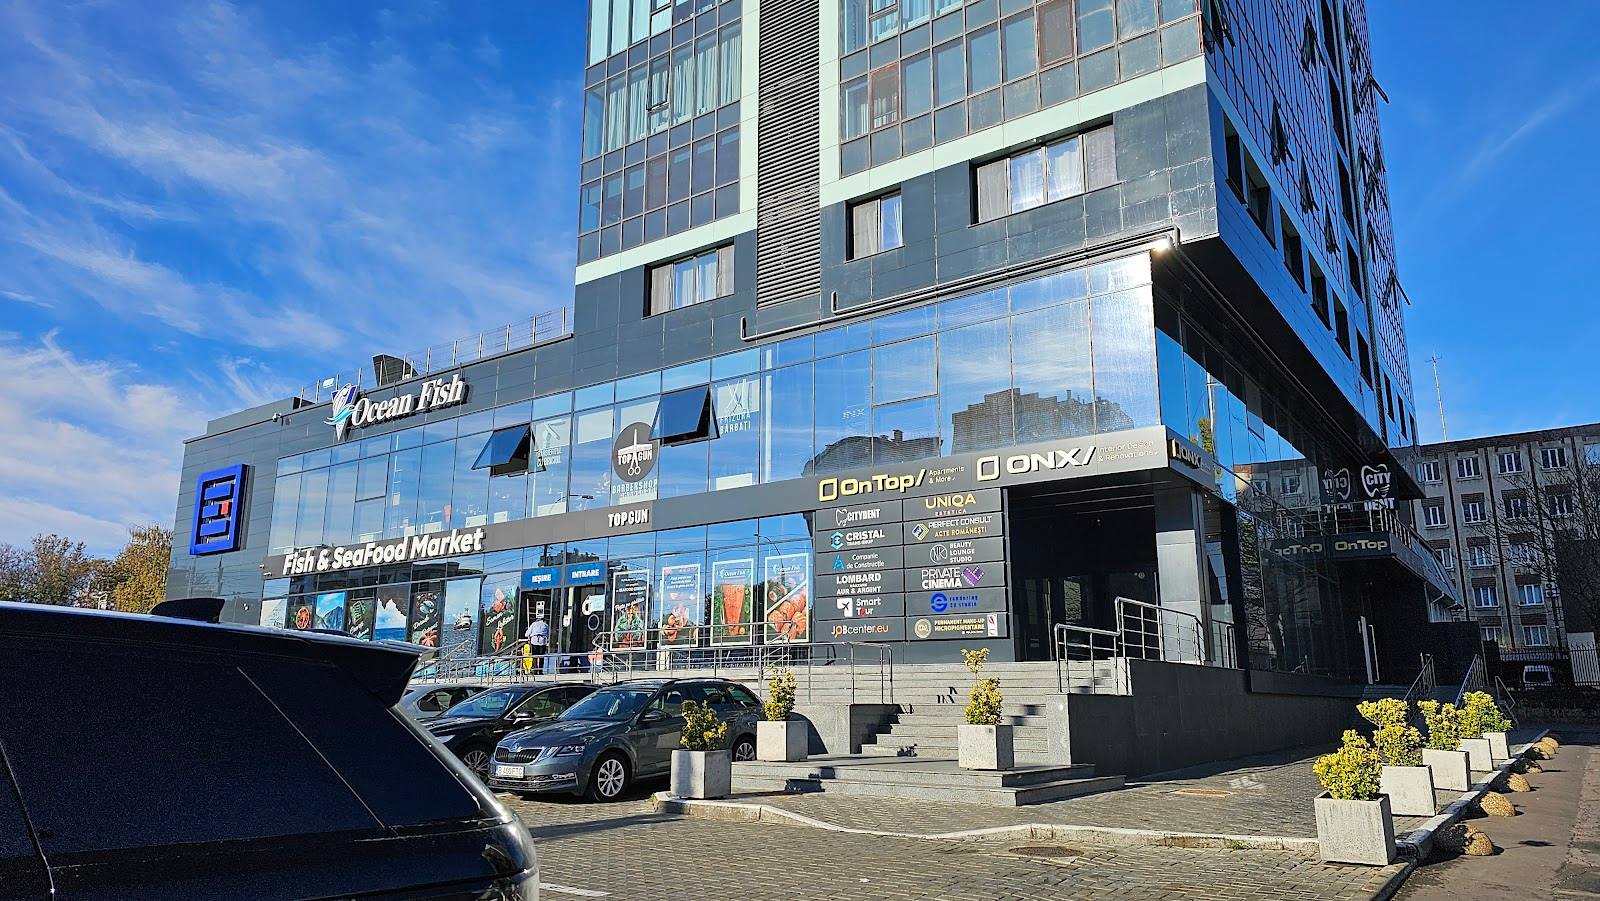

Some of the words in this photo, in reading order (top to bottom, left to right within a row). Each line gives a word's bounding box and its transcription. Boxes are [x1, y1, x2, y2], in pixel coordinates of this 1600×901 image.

[352, 393, 412, 426] Ocean
[416, 374, 464, 411] Fish
[1098, 443, 1125, 453] Interior
[618, 453, 632, 465] TOP
[638, 450, 652, 461] GUN
[929, 466, 965, 476] Apartments
[1366, 472, 1391, 485] CITY
[612, 479, 657, 494] BARBERSHOP
[925, 493, 976, 509] UNIQA
[847, 509, 880, 521] CITYDENT
[929, 519, 959, 528] PERFECT
[961, 516, 992, 526] CONSULT
[846, 529, 885, 541] CRISTAL
[949, 541, 972, 549] BEAUTY
[1334, 539, 1388, 551] OnTop
[283, 552, 315, 575] Fish
[317, 549, 329, 571] &
[332, 536, 409, 569] SeaFood
[410, 528, 485, 559] Market
[852, 553, 878, 561] Companie
[571, 569, 600, 579] INTRARE
[837, 573, 881, 584] LOMBARD
[921, 567, 960, 579] PRIVATE
[922, 578, 962, 589] CINEMA
[857, 586, 881, 594] ARGINT
[856, 597, 881, 606] Smart
[831, 624, 889, 638] JOBcenter.eu
